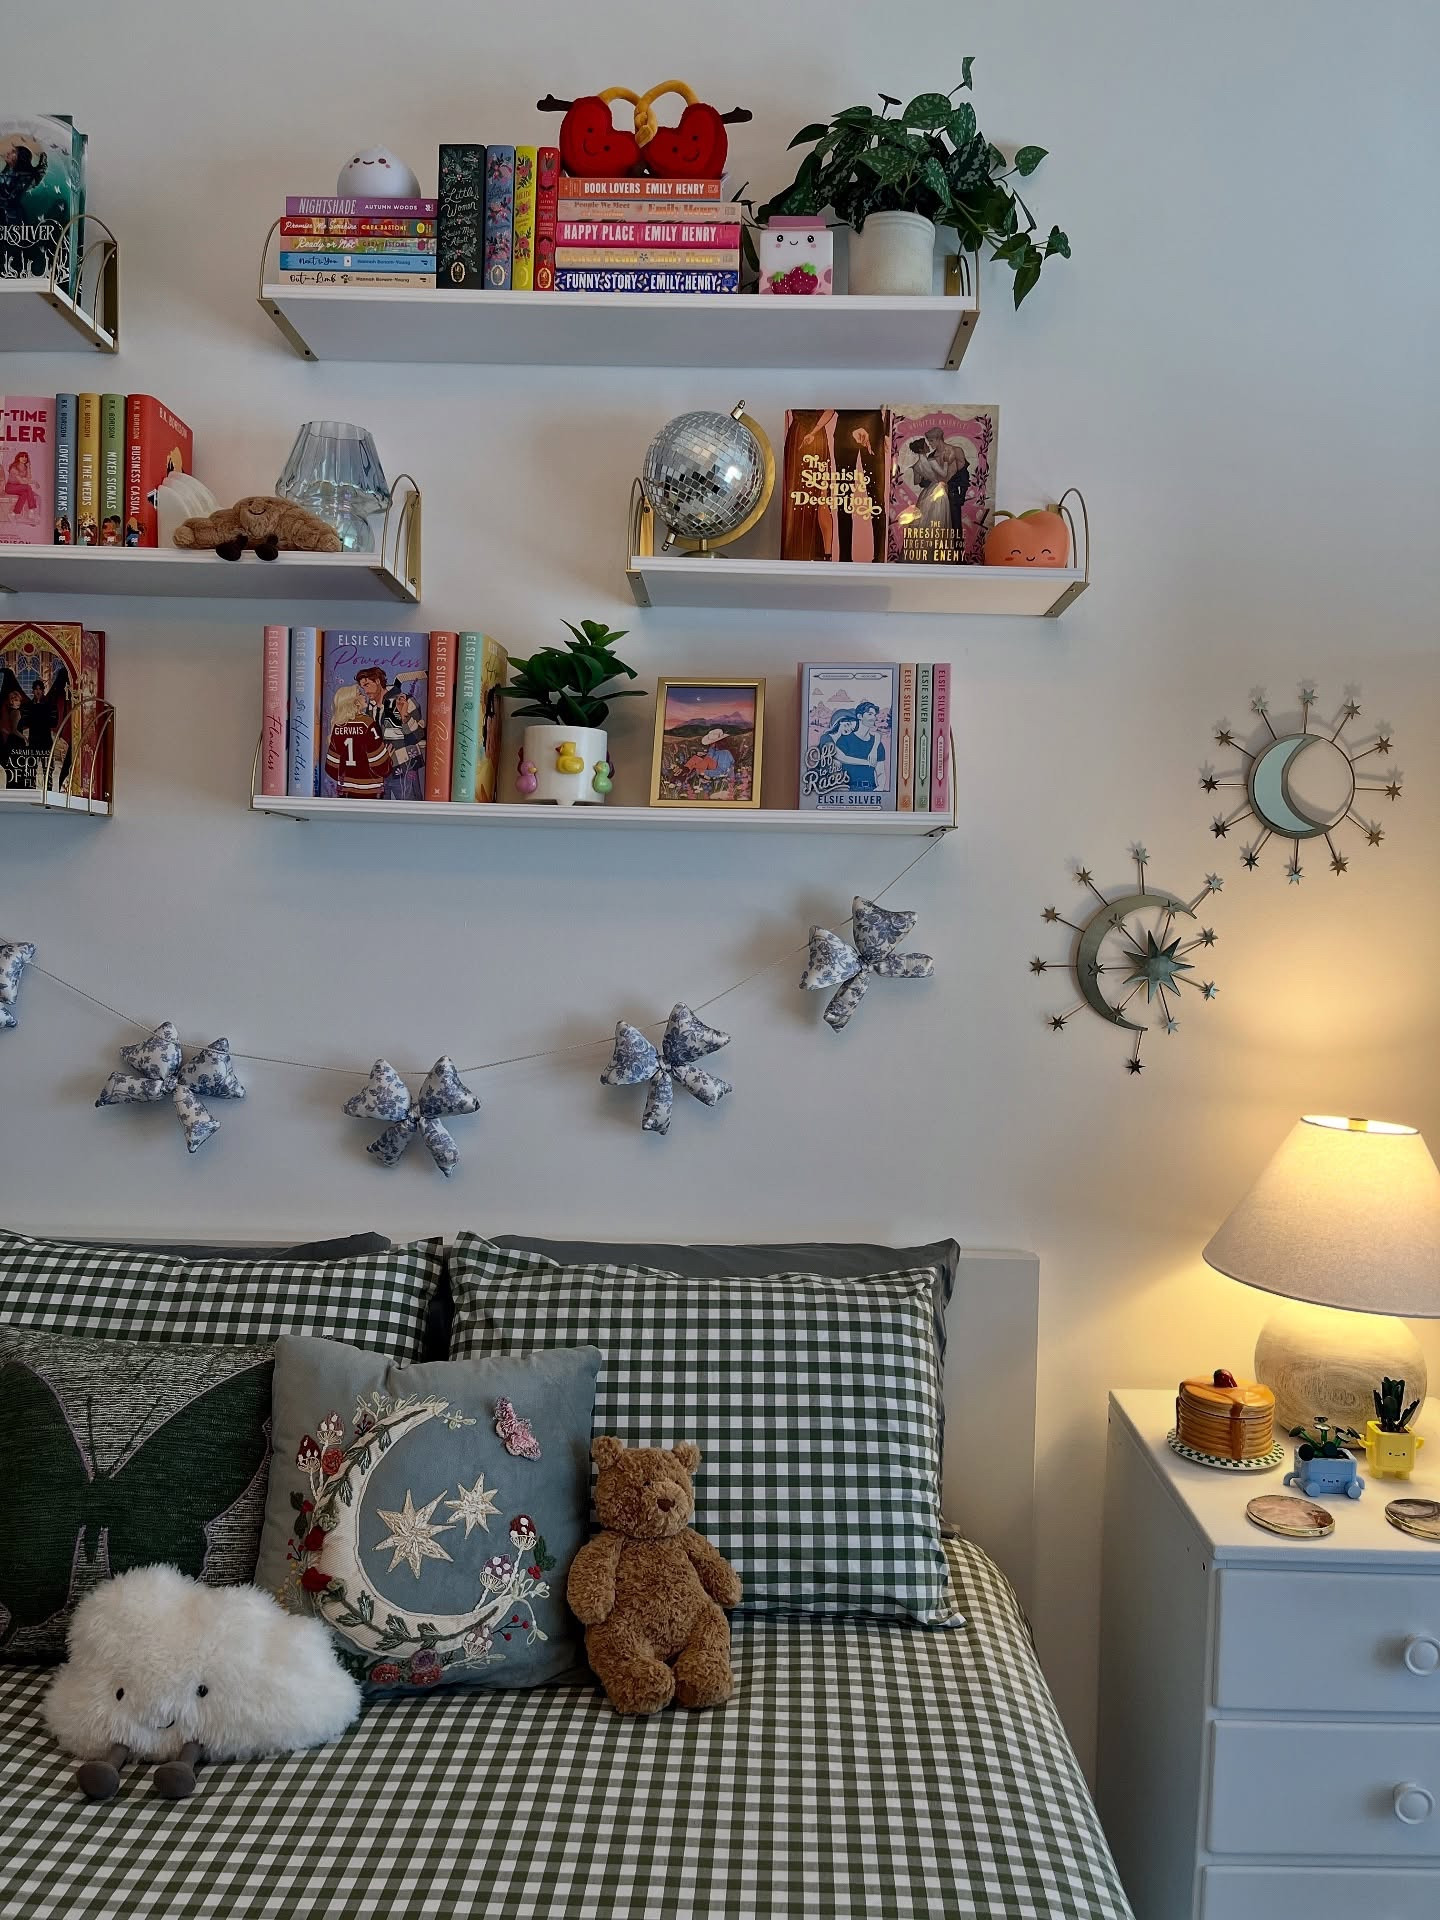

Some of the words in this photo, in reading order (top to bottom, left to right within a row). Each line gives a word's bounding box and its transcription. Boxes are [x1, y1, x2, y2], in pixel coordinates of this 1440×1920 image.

[444, 186, 475, 203] Little
[584, 182, 608, 194] BOOK
[609, 182, 642, 194] LOVERS
[645, 183, 673, 195] EMILY
[675, 183, 705, 195] HENRY
[298, 198, 357, 215] NIGHTSHADE
[440, 202, 478, 217] Women
[648, 203, 679, 217] Emily
[683, 204, 718, 219] Henry
[295, 237, 325, 251] Ready
[563, 224, 598, 241] HAPPY
[602, 225, 635, 241] PLACE
[644, 225, 678, 242] EMILY
[681, 226, 717, 242] HENRY
[566, 273, 601, 289] FUNNY
[604, 274, 638, 290] STORY
[650, 274, 681, 290] EMILY
[685, 275, 718, 291] HENRY
[60, 412, 68, 438] BORISON
[84, 412, 92, 438] BORISON
[108, 412, 116, 439] BORISON
[57, 444, 69, 484] LOVELIGHT
[82, 453, 92, 463] IN
[107, 451, 117, 475] MIXED
[131, 445, 141, 484] BUSINESS
[802, 454, 829, 473] The
[82, 464, 92, 479] THE
[801, 468, 870, 490] Spanish
[57, 486, 68, 512] FARMS
[81, 482, 92, 506] WEEDS
[106, 477, 117, 510] SIGNALS
[130, 485, 141, 516] CASUAL
[829, 482, 867, 496] Love
[790, 492, 882, 520] Deception
[903, 527, 967, 539] IRRESISTIBLE
[930, 520, 941, 528] THE
[903, 539, 925, 549] URGE
[925, 540, 933, 548] TO
[934, 539, 955, 550] FALL
[955, 540, 967, 548] FOR
[903, 549, 928, 561] YOUR
[933, 549, 966, 562] ENEMY
[268, 630, 279, 657] ELSIE
[295, 631, 306, 657] ELSIE
[338, 634, 368, 646] ELSIE
[373, 635, 411, 647] SILVER
[436, 636, 448, 663] ELSIE
[465, 635, 477, 662] ELSIE
[330, 645, 420, 671] Powerless
[267, 658, 279, 693] SILVER
[295, 659, 305, 694] SILVER
[435, 664, 447, 699] SILVER
[463, 663, 476, 698] SILVER
[903, 669, 912, 692] ELSIE
[921, 669, 930, 692] ELSIE
[937, 669, 946, 692] ELSIE
[903, 694, 912, 723] SILVER
[921, 694, 929, 723] SILVER
[937, 694, 946, 723] SILVER
[266, 714, 283, 770] Flawless
[334, 727, 364, 736] GERVAIS
[370, 727, 380, 741] 1
[11, 748, 30, 756] SARAH
[291, 715, 310, 781] Heartless
[344, 737, 357, 767] 1
[805, 744, 837, 768] Off
[6, 756, 18, 769] A
[819, 768, 828, 777] to
[828, 762, 843, 773] the
[803, 770, 851, 796] Races
[817, 795, 845, 804] ELSIE
[848, 795, 882, 805] SILVER
